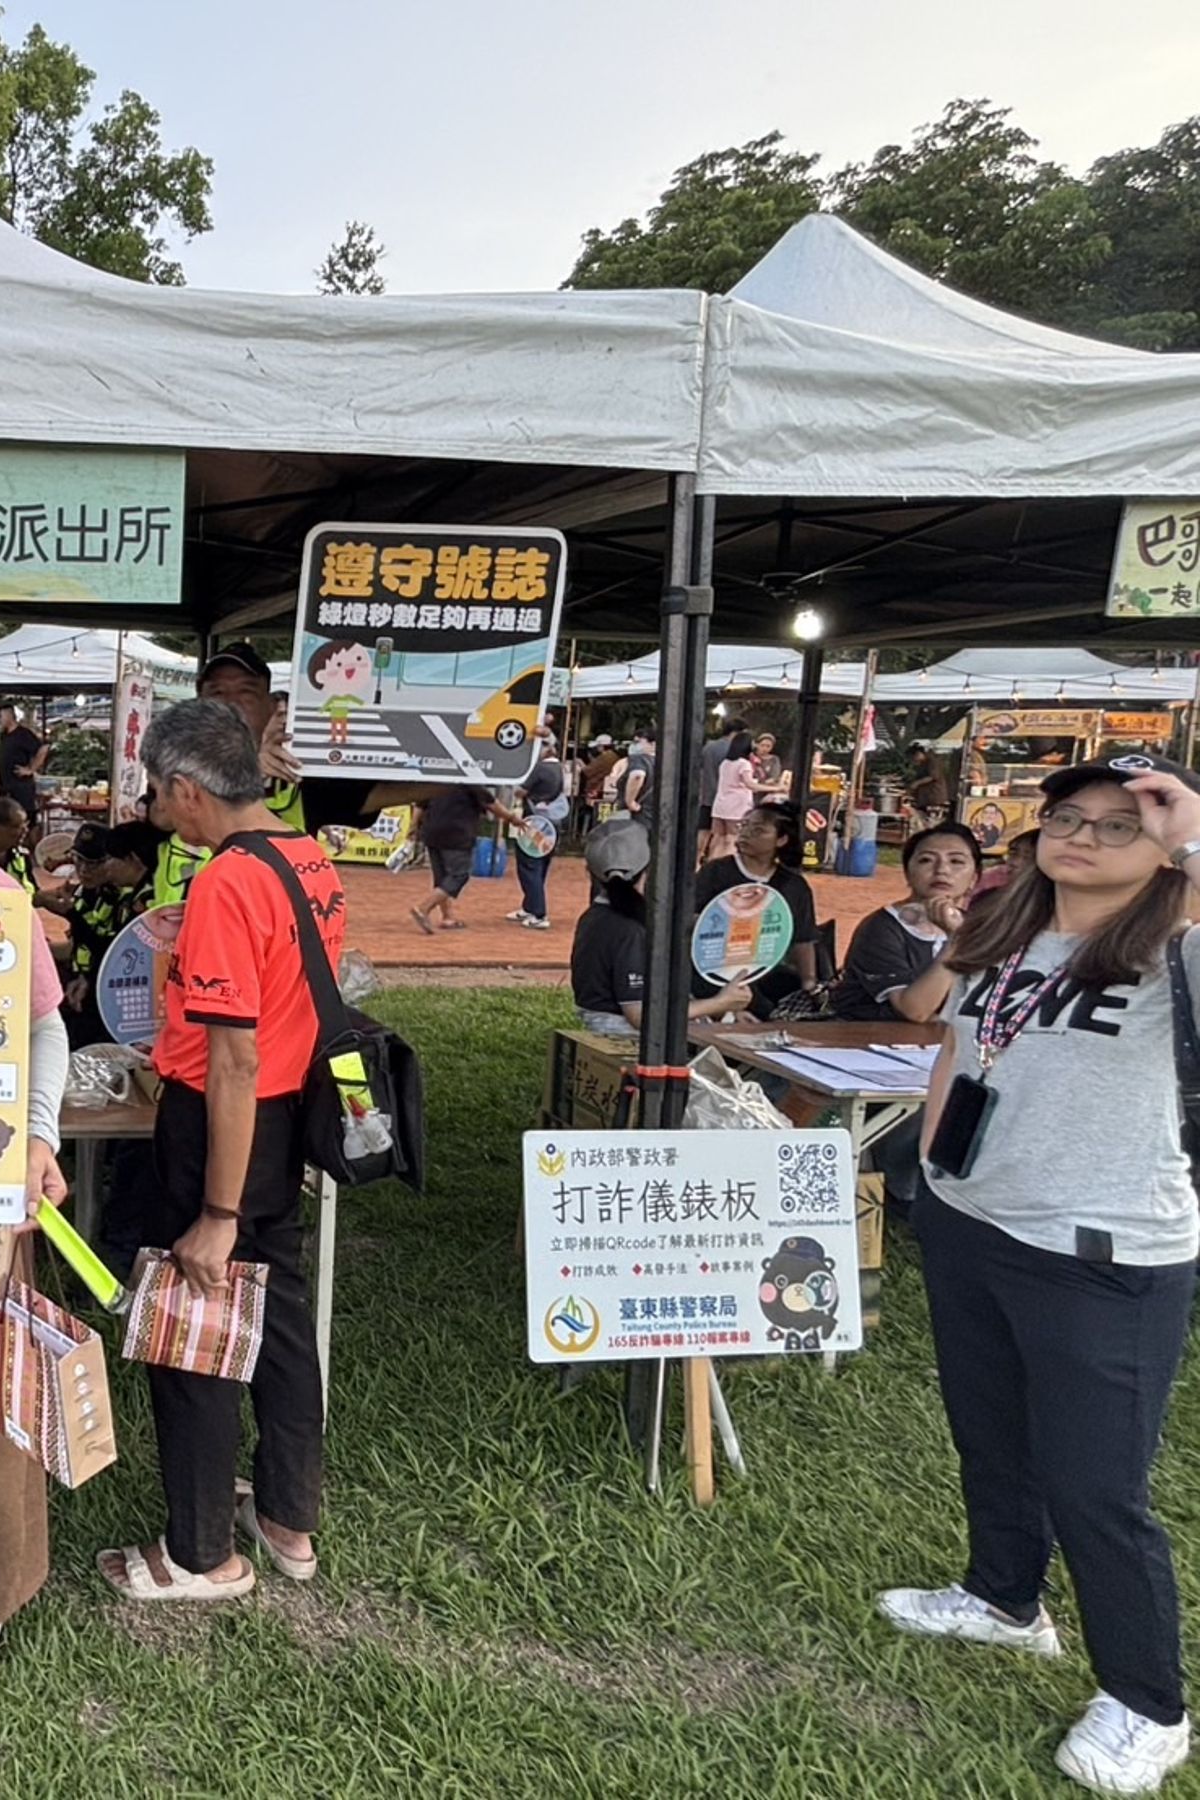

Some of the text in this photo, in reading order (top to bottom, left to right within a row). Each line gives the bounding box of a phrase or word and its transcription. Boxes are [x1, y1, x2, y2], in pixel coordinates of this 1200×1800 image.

[318, 541, 550, 601] 遵守號誌
[1148, 581, 1200, 609] 一起
[318, 601, 542, 633] 綠燈秒數足夠再通過
[570, 1147, 679, 1168] 內政部警政署
[552, 1178, 761, 1225] 打詐儀錶板
[619, 1295, 738, 1320] 臺東縣警察局
[654, 1321, 681, 1331] County
[683, 1320, 707, 1329] Police
